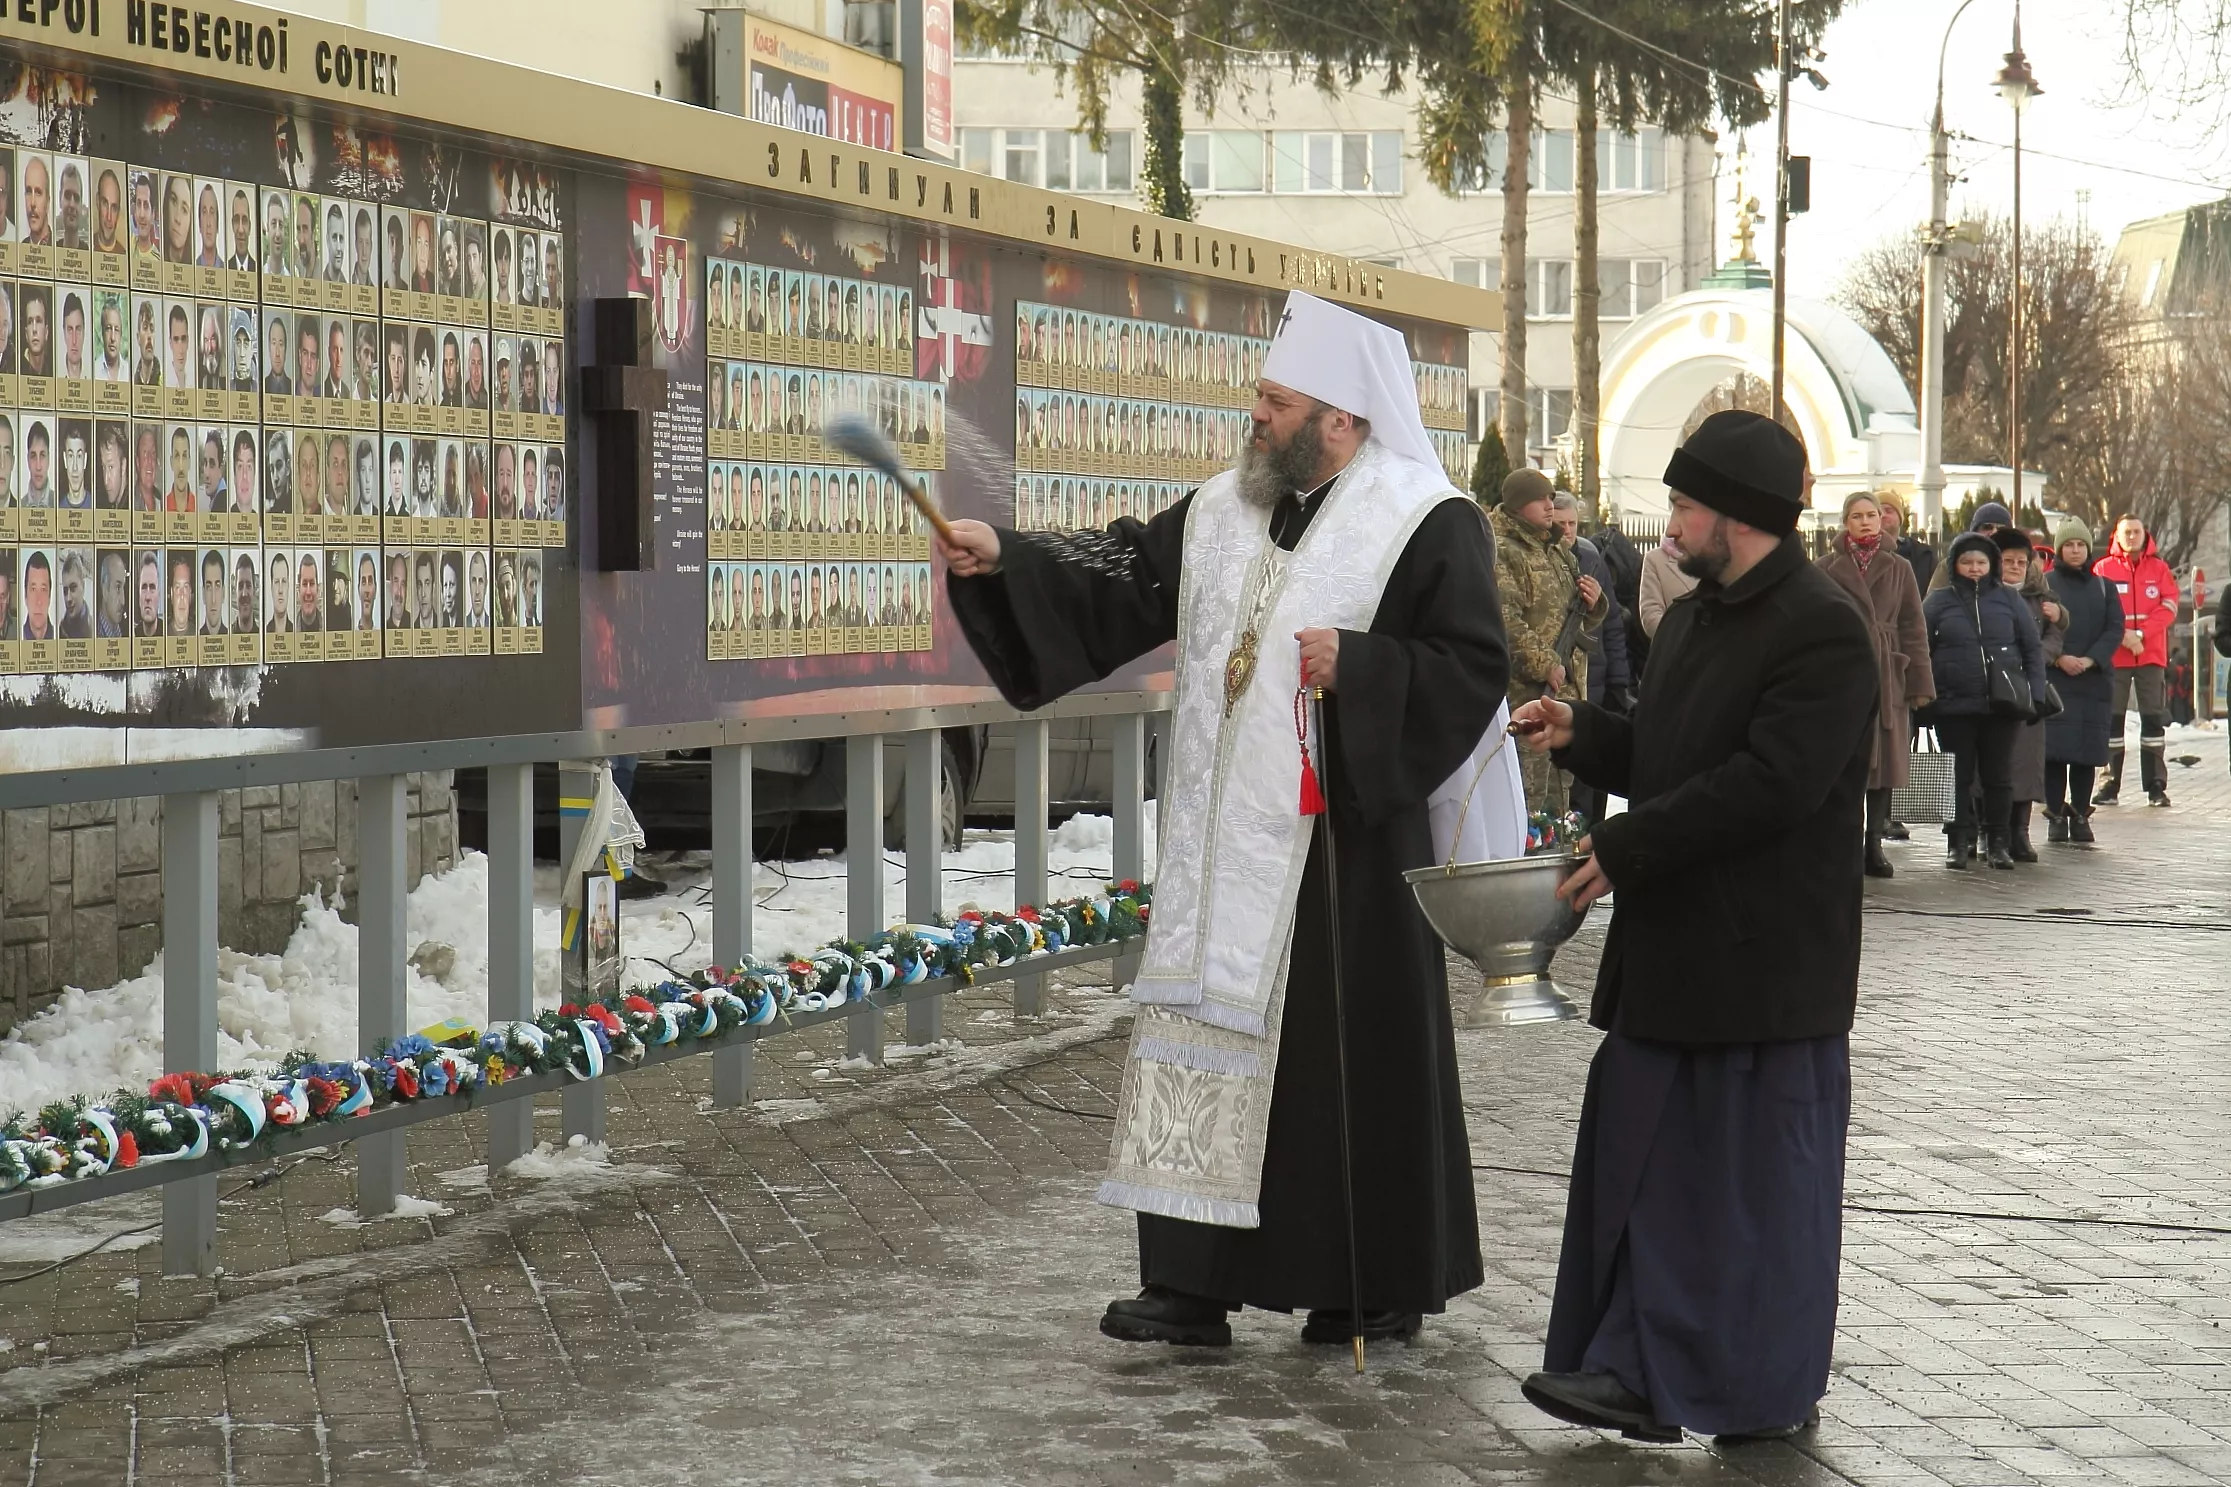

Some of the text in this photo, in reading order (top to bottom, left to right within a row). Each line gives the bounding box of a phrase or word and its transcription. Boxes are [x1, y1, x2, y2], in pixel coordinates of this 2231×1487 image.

[127, 0, 289, 74] НЕБЕСНОЇ
[315, 40, 399, 97] СОТНІ
[768, 142, 980, 220] ЗАГИНУЛИ
[1046, 205, 1079, 240] ЗА
[1132, 224, 1256, 275] ЄДНІСТЬ
